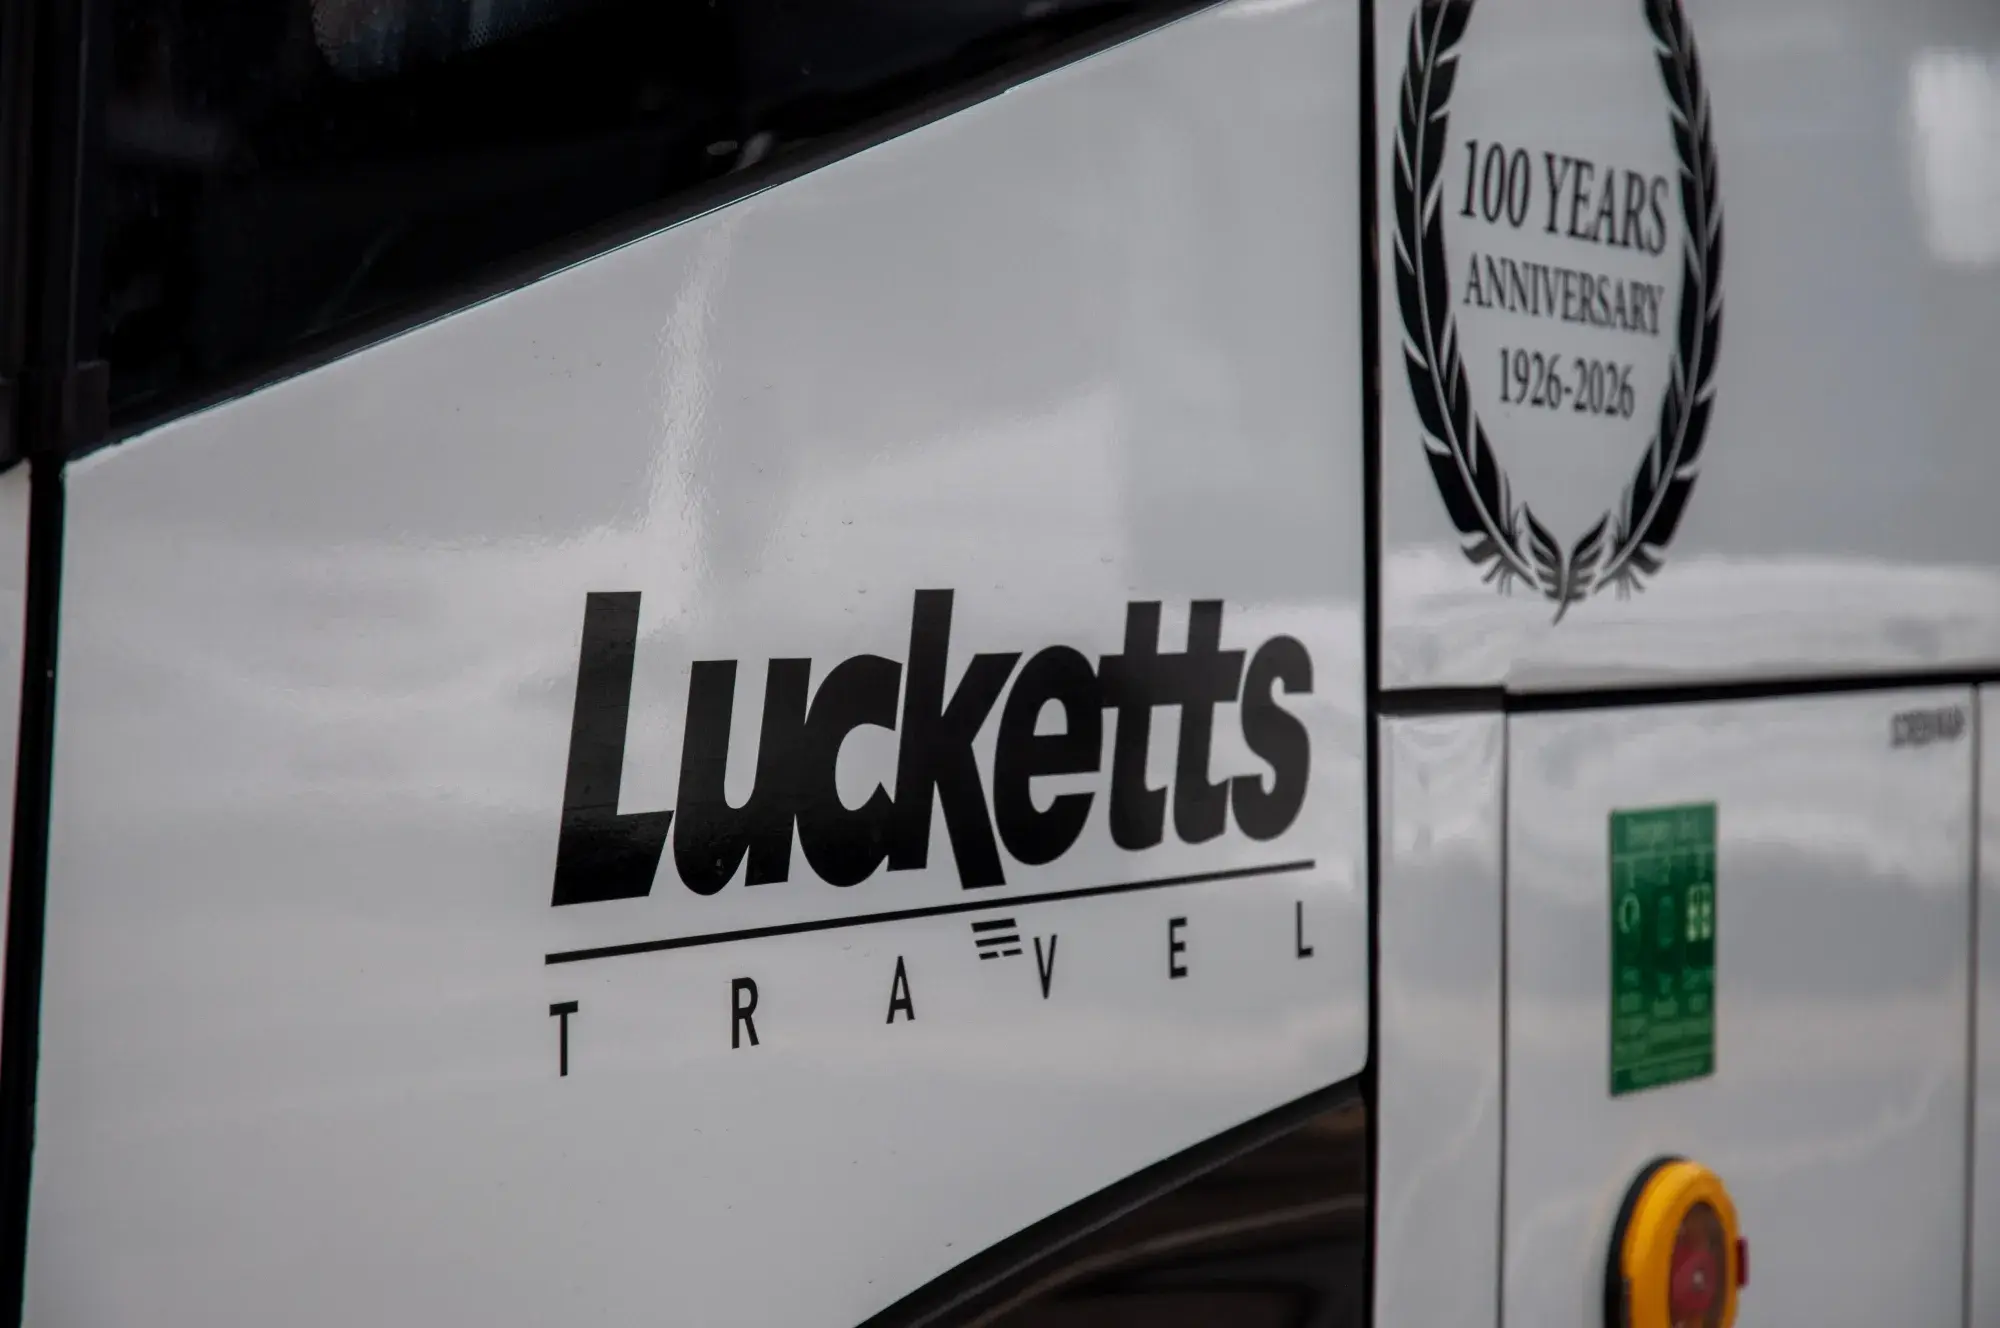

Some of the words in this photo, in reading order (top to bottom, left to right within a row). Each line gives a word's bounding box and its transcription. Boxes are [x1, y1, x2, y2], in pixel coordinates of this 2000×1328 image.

[1459, 138, 1531, 228] 100
[1544, 150, 1669, 257] YEARS
[1462, 251, 1665, 336] ANNIVERSARY
[1499, 347, 1636, 420] 1926-2026
[551, 588, 1314, 907] Lucketts
[548, 900, 1314, 1077] TRAVEL
